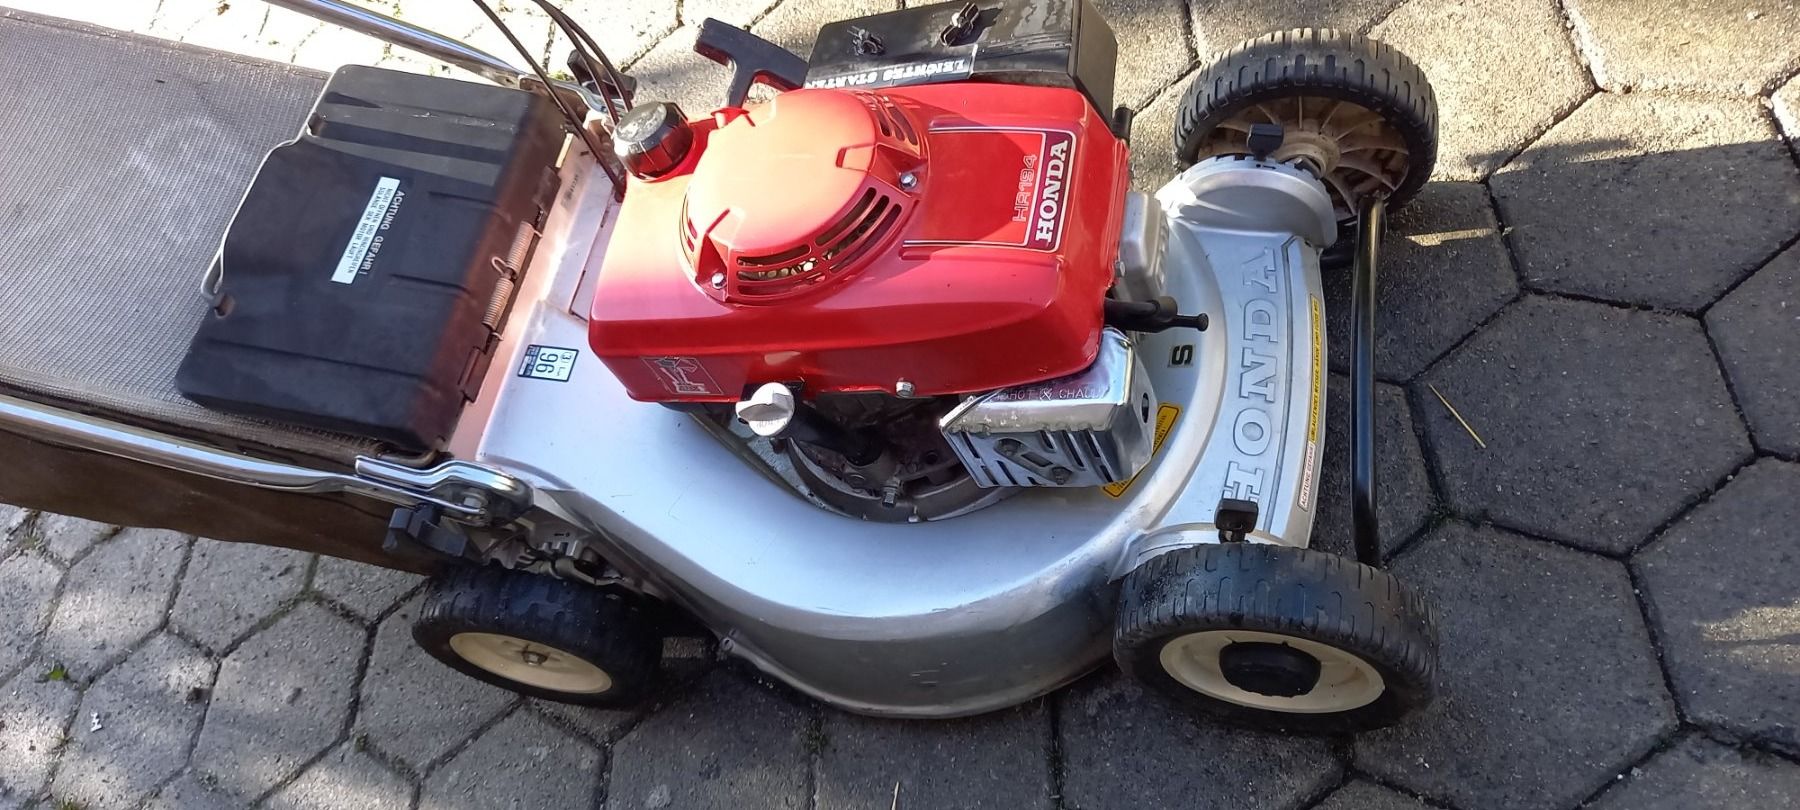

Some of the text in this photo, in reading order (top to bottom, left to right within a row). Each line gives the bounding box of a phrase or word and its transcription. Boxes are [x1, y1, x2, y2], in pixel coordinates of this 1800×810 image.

[380, 190, 406, 230] ACHTUNG
[1035, 140, 1069, 243] HONDA
[535, 352, 559, 374] 96
[1171, 344, 1193, 366] S
[1220, 248, 1279, 502] HONDA
